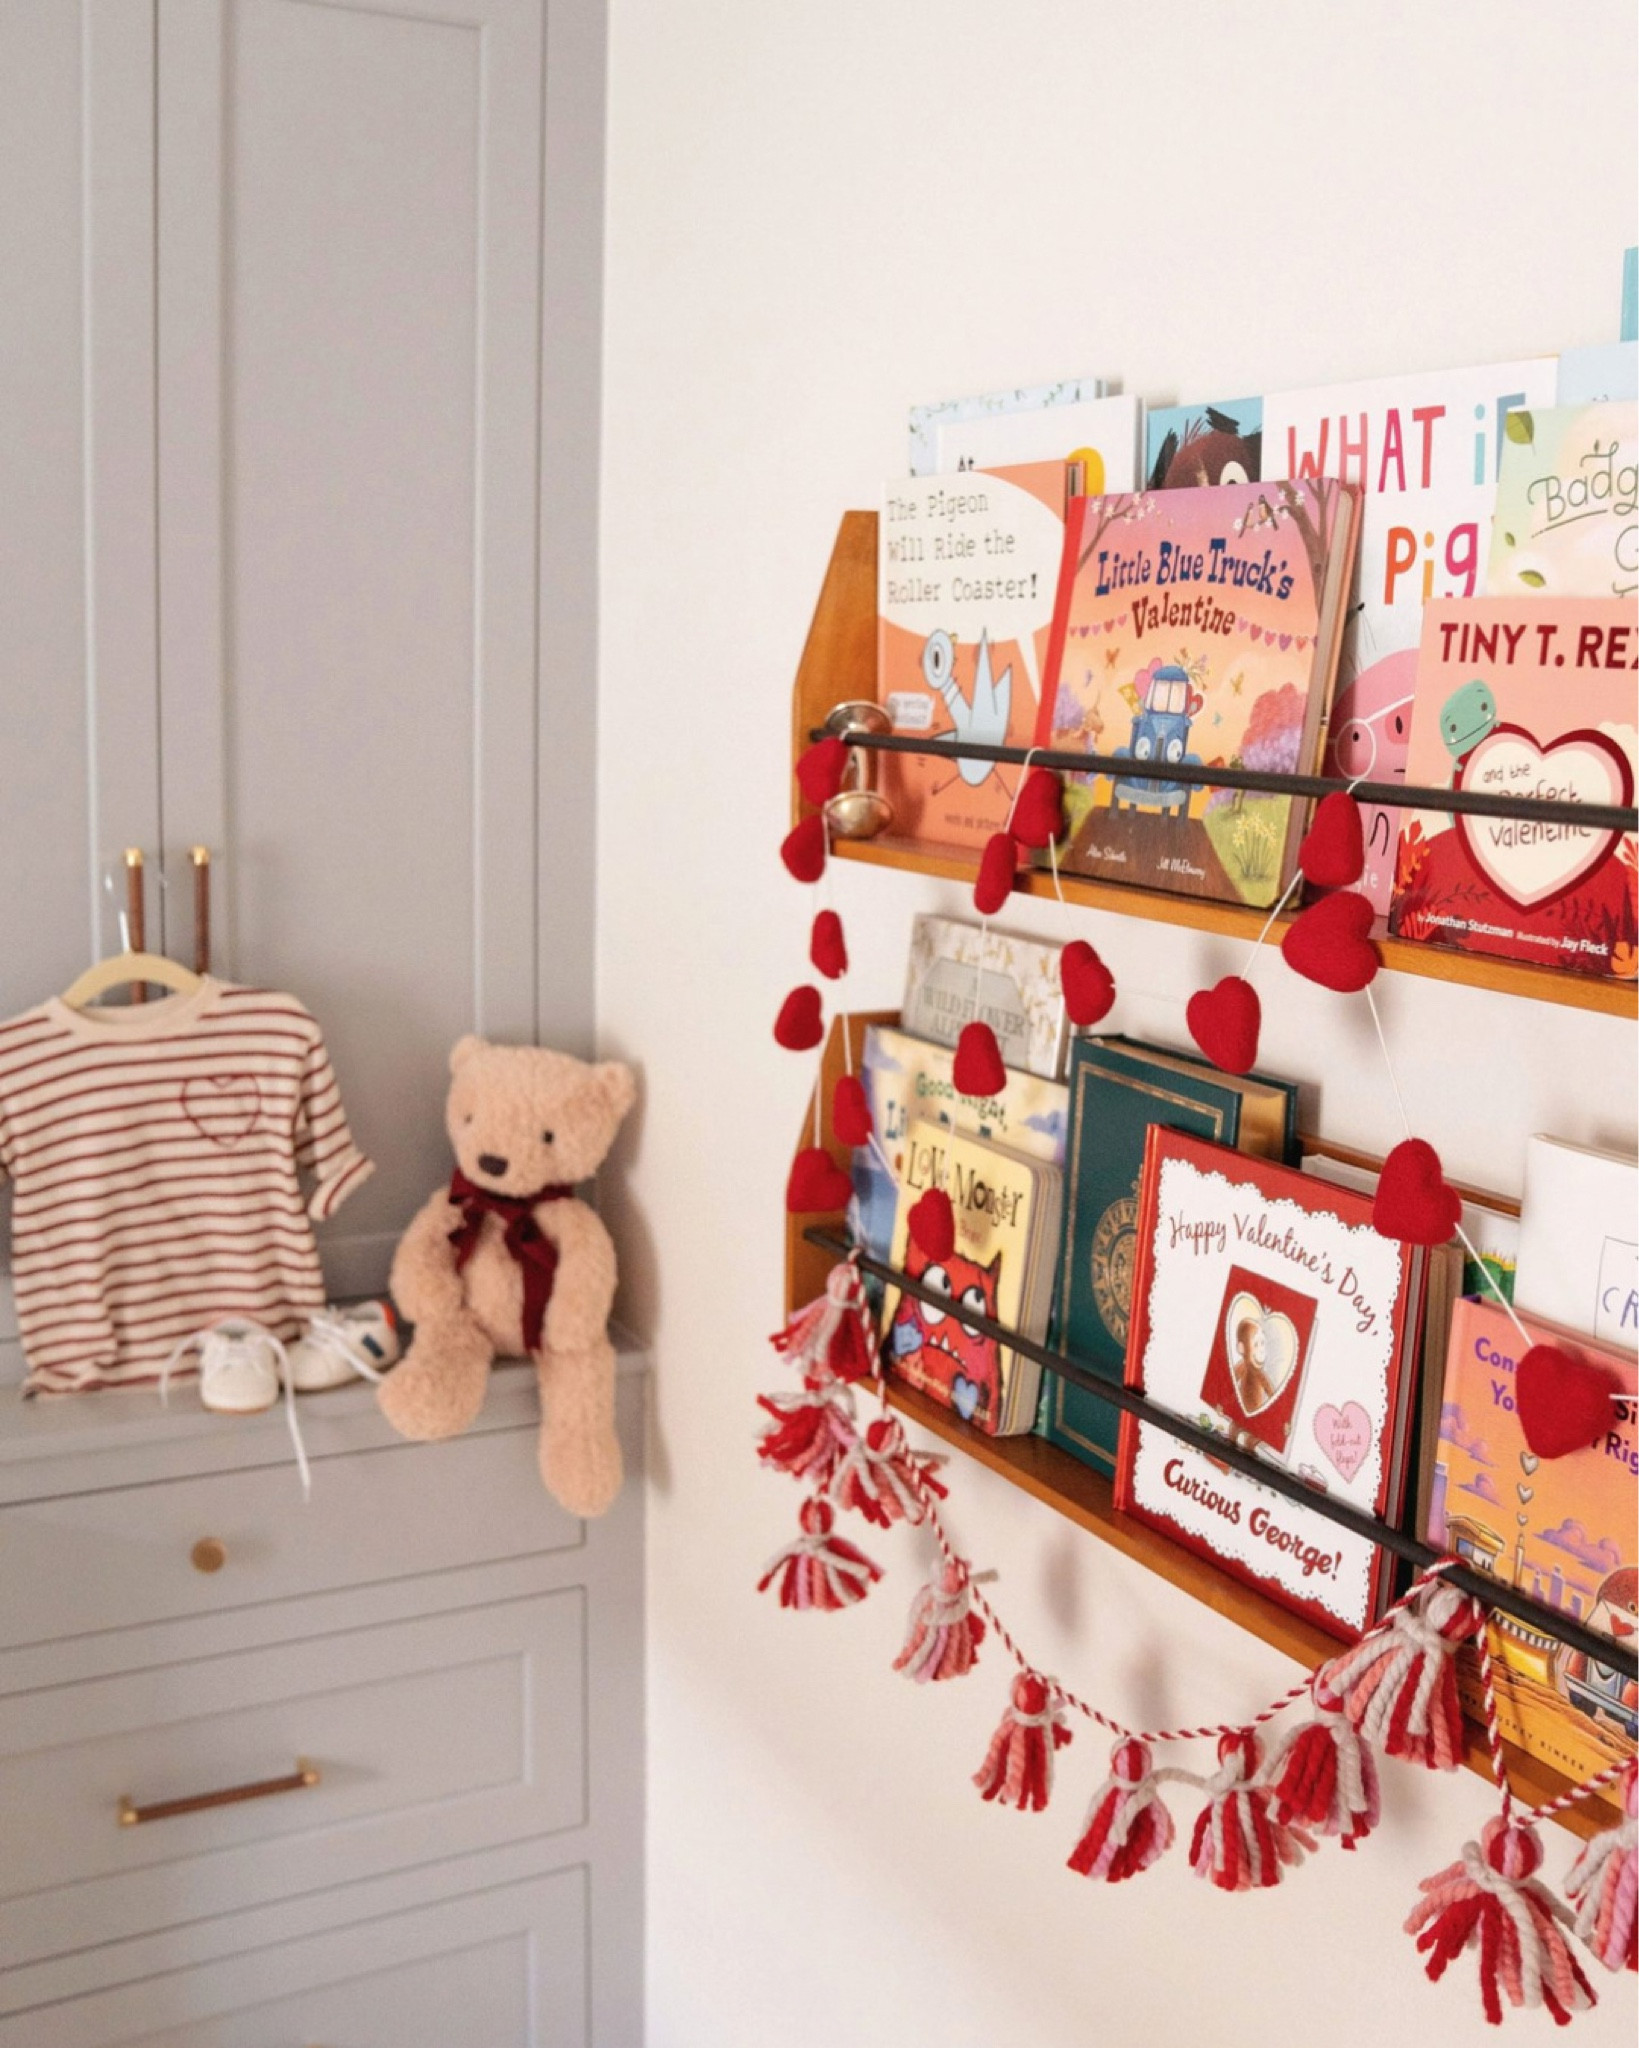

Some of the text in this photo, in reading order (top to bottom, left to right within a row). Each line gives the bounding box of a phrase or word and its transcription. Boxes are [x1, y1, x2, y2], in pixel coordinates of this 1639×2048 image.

[1288, 405, 1446, 494] WHAT
[887, 490, 989, 523] The Pigeon
[887, 528, 1015, 562] Will Ride the
[1384, 523, 1478, 606] Pig
[888, 572, 1037, 604] Roller Coaster!
[1095, 538, 1295, 600] Little Blue Truck's
[1131, 592, 1236, 639] Valentine
[1440, 622, 1526, 665] TINY
[1536, 625, 1565, 667] T.
[1483, 763, 1530, 783] and the
[1425, 912, 1467, 929] Jonathan
[1560, 935, 1579, 953] Jay
[955, 1163, 1023, 1227] Monster
[1170, 1210, 1378, 1336] Happy Valentine's Day,
[1475, 1337, 1518, 1373] Con
[1491, 1379, 1518, 1414] Yo
[1163, 1458, 1342, 1581] Curious George!
